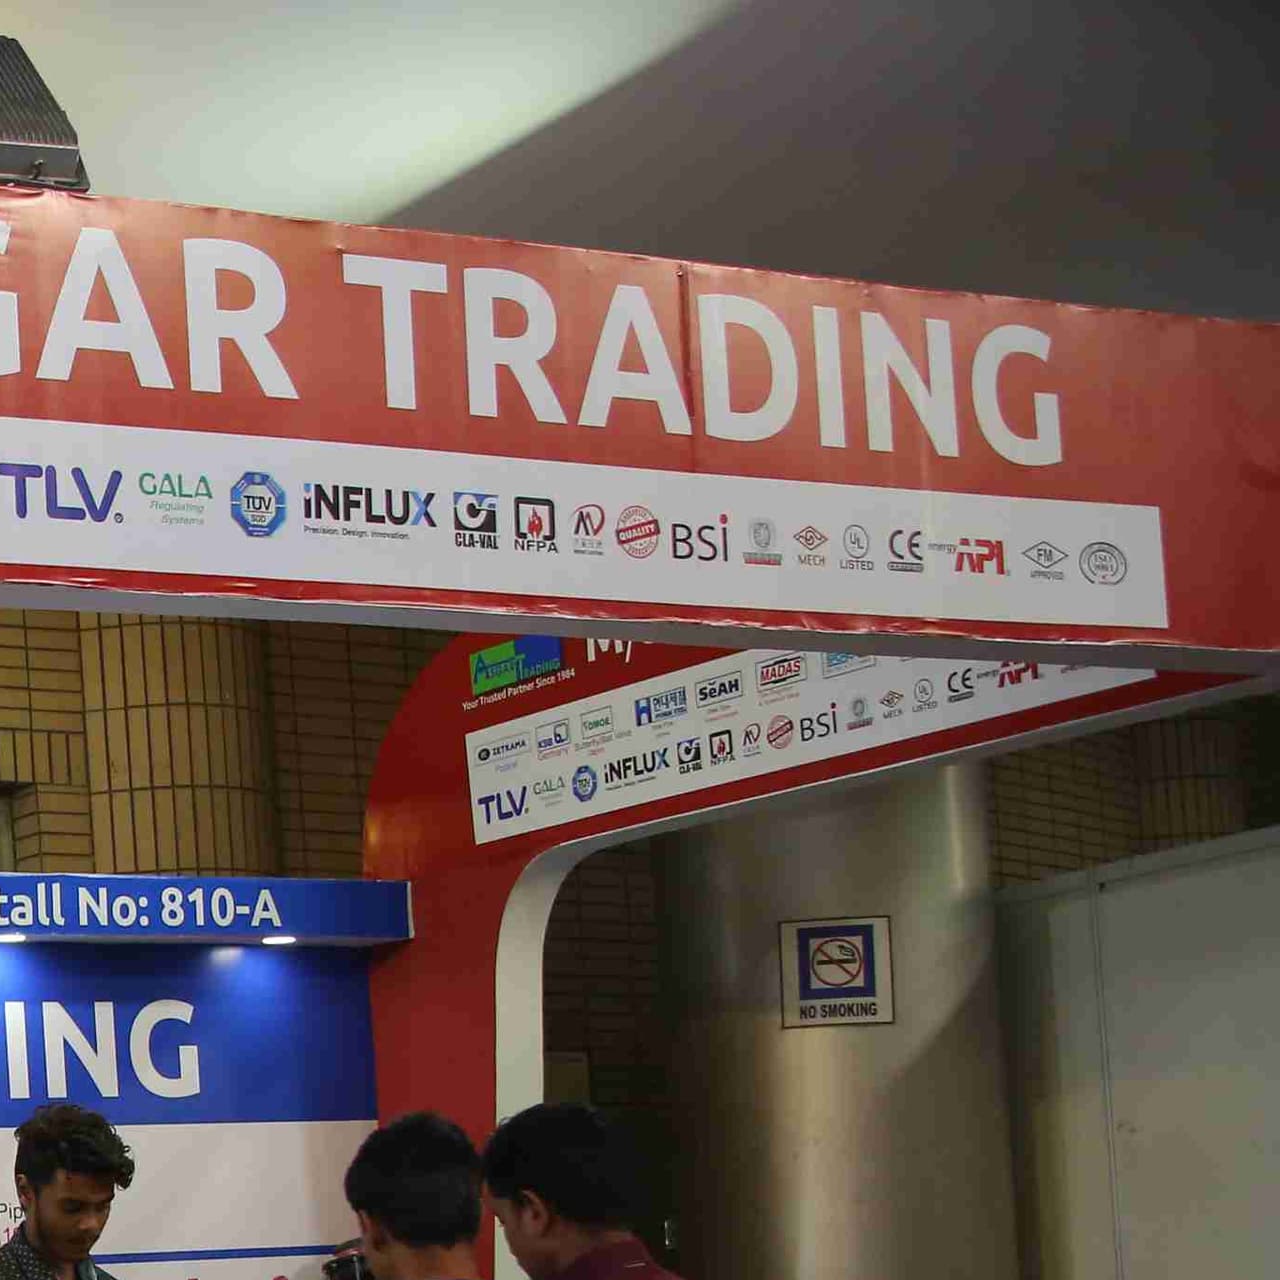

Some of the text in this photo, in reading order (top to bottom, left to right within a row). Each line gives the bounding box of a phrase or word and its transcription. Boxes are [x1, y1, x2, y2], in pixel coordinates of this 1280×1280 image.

[342, 253, 1062, 466] TRADING
[139, 472, 213, 499] GALA
[619, 523, 655, 540] QUALITY
[455, 532, 499, 550] CLA-VAL
[514, 539, 559, 554] NFPA
[849, 532, 865, 550] UL
[888, 529, 923, 561] CE
[1037, 548, 1053, 563] FM
[840, 559, 874, 571] LISTED
[760, 657, 802, 683] MADAS
[477, 785, 527, 825] TLV
[76, 886, 150, 928] No:
[160, 886, 283, 929] 810-A
[800, 1002, 878, 1020] NO SMOKING
